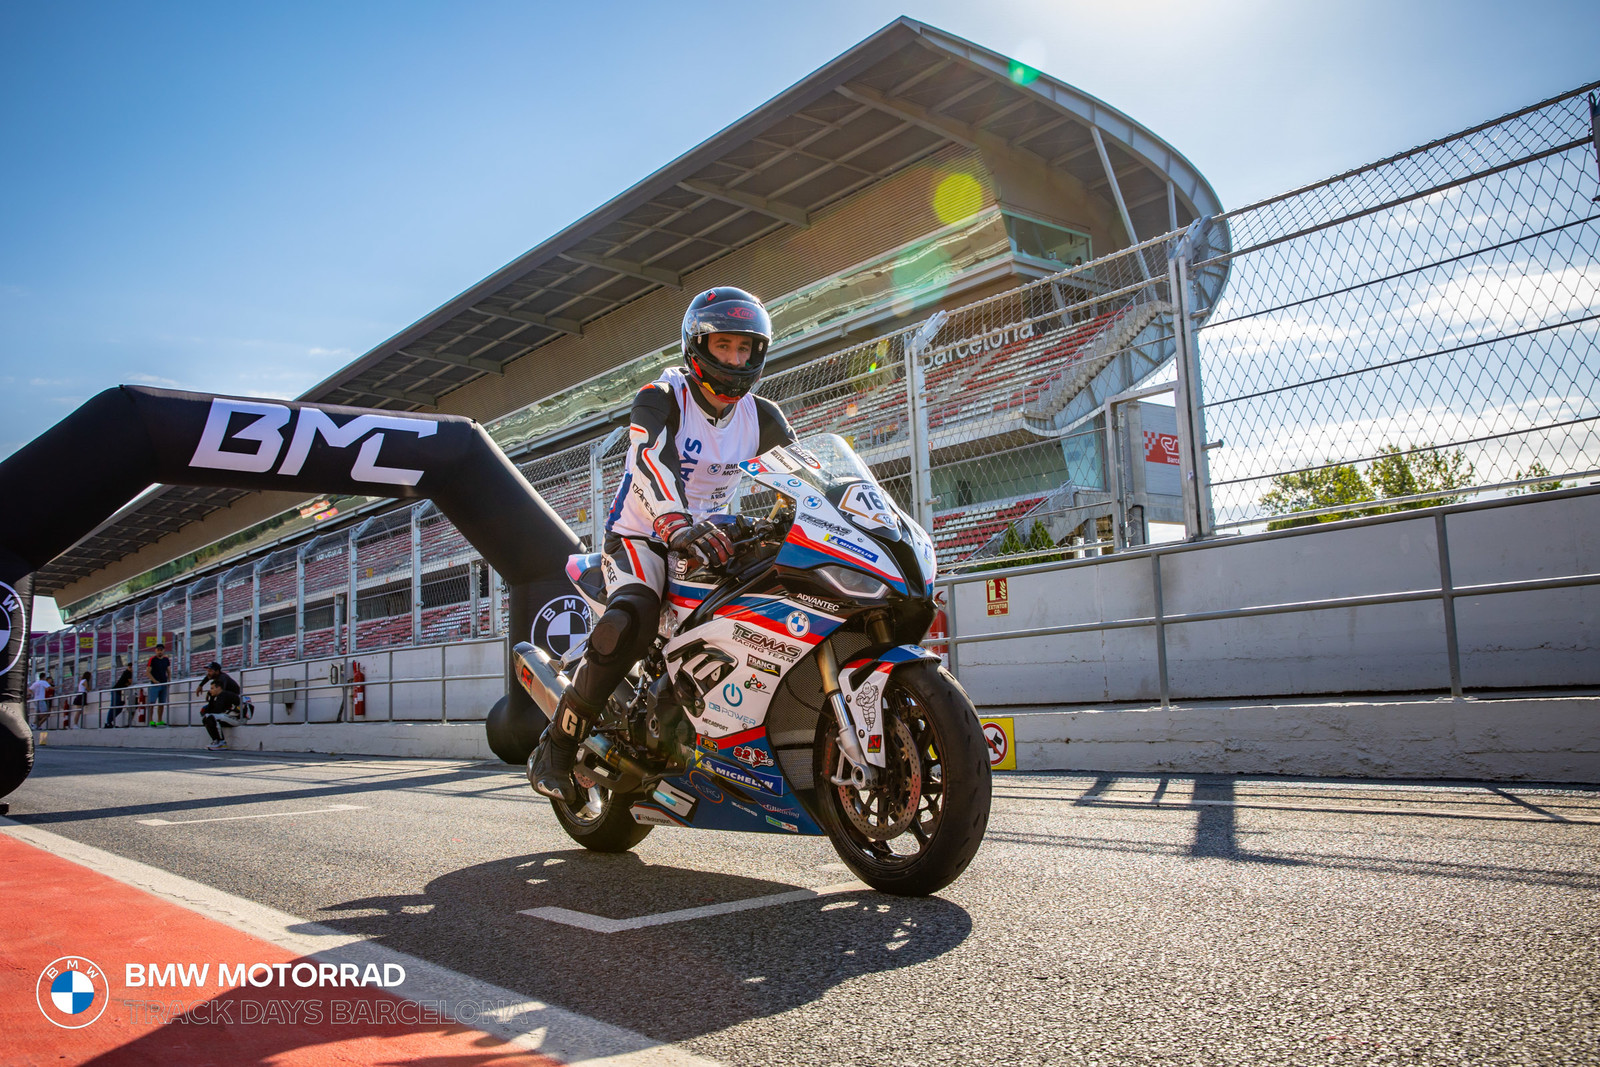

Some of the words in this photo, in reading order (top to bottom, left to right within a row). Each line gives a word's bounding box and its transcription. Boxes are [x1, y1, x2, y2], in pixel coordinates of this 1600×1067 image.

[922, 319, 1034, 370] Barcelona
[188, 398, 438, 487] BMC
[679, 437, 702, 491] AYS
[856, 491, 885, 510] 16
[839, 541, 874, 559] MICHELIN
[542, 599, 590, 622] BMW
[796, 593, 839, 611] ADVANTEC
[732, 636, 764, 654] RACING
[767, 651, 795, 664] TEAM
[733, 623, 802, 658] TECMAS
[748, 656, 776, 670] FRANCE
[721, 707, 757, 725] POWER
